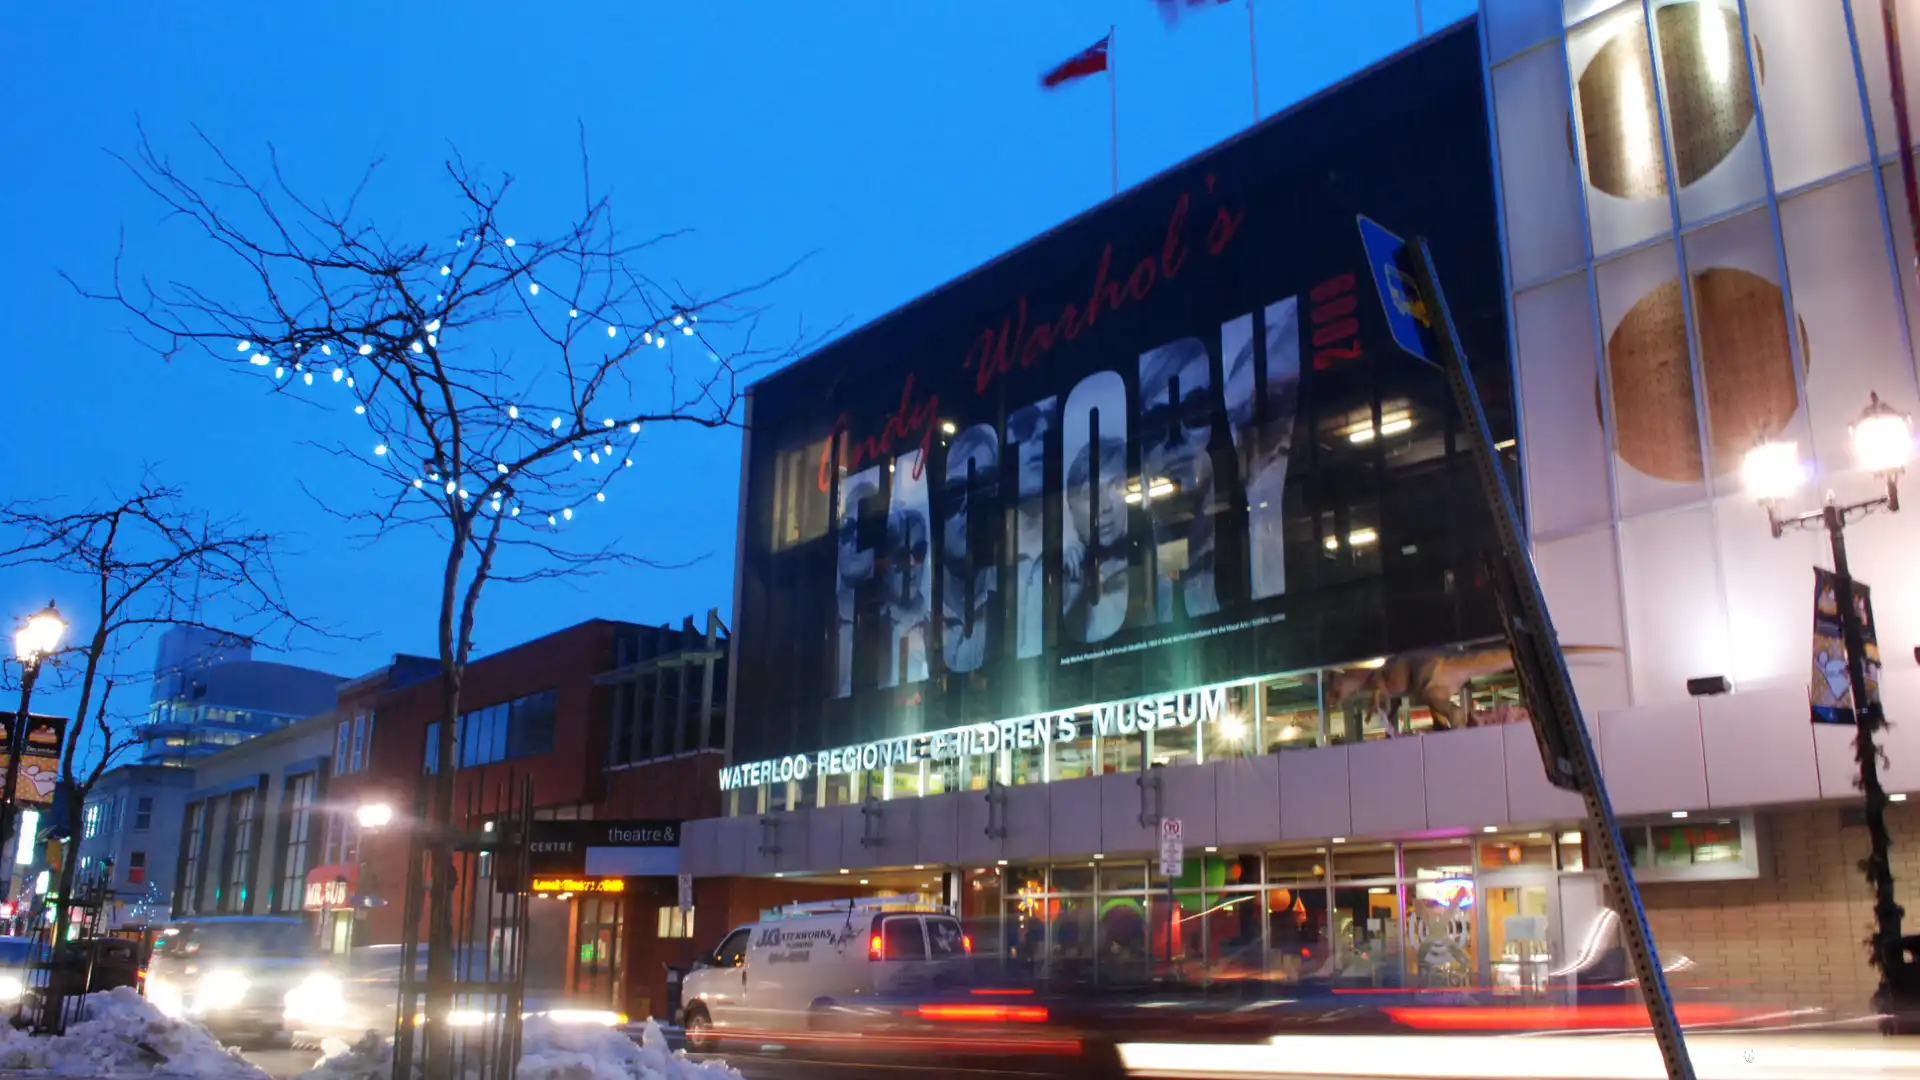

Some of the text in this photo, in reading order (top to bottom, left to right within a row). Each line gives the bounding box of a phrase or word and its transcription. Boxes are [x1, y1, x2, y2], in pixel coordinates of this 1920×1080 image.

[963, 172, 1245, 395] Warhol's
[836, 294, 1301, 699] FACTORY
[719, 754, 808, 791] WATERLOO
[817, 740, 919, 776] REGIONAL
[1092, 687, 1227, 737] MUSEUM
[530, 841, 574, 853] CENTRE
[608, 827, 662, 842] theatre
